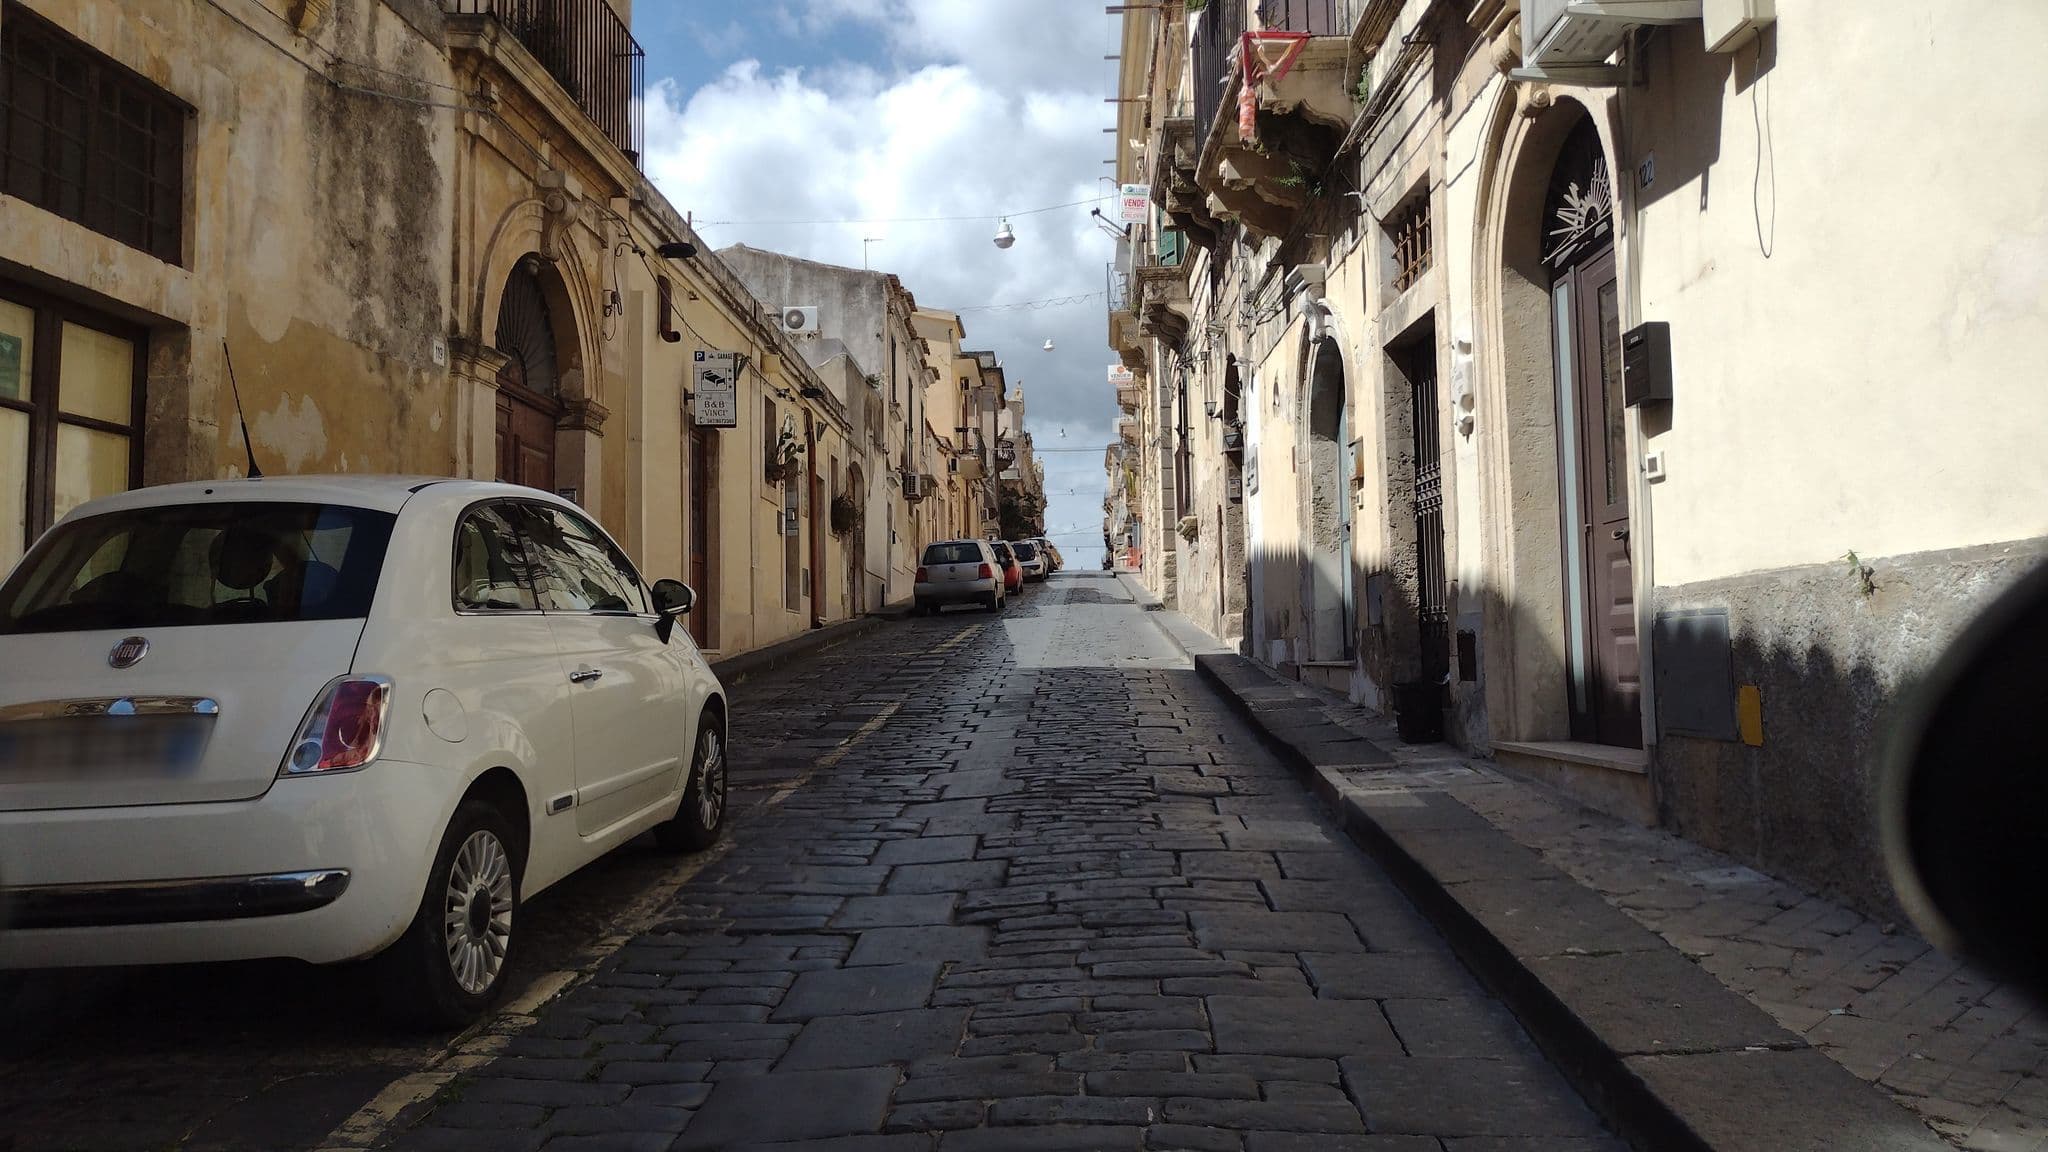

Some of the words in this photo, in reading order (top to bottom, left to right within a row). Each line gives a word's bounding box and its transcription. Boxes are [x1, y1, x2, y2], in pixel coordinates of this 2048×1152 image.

[1639, 160, 1653, 189] 122
[1124, 198, 1145, 207] VENDE
[717, 352, 733, 360] GARAGE
